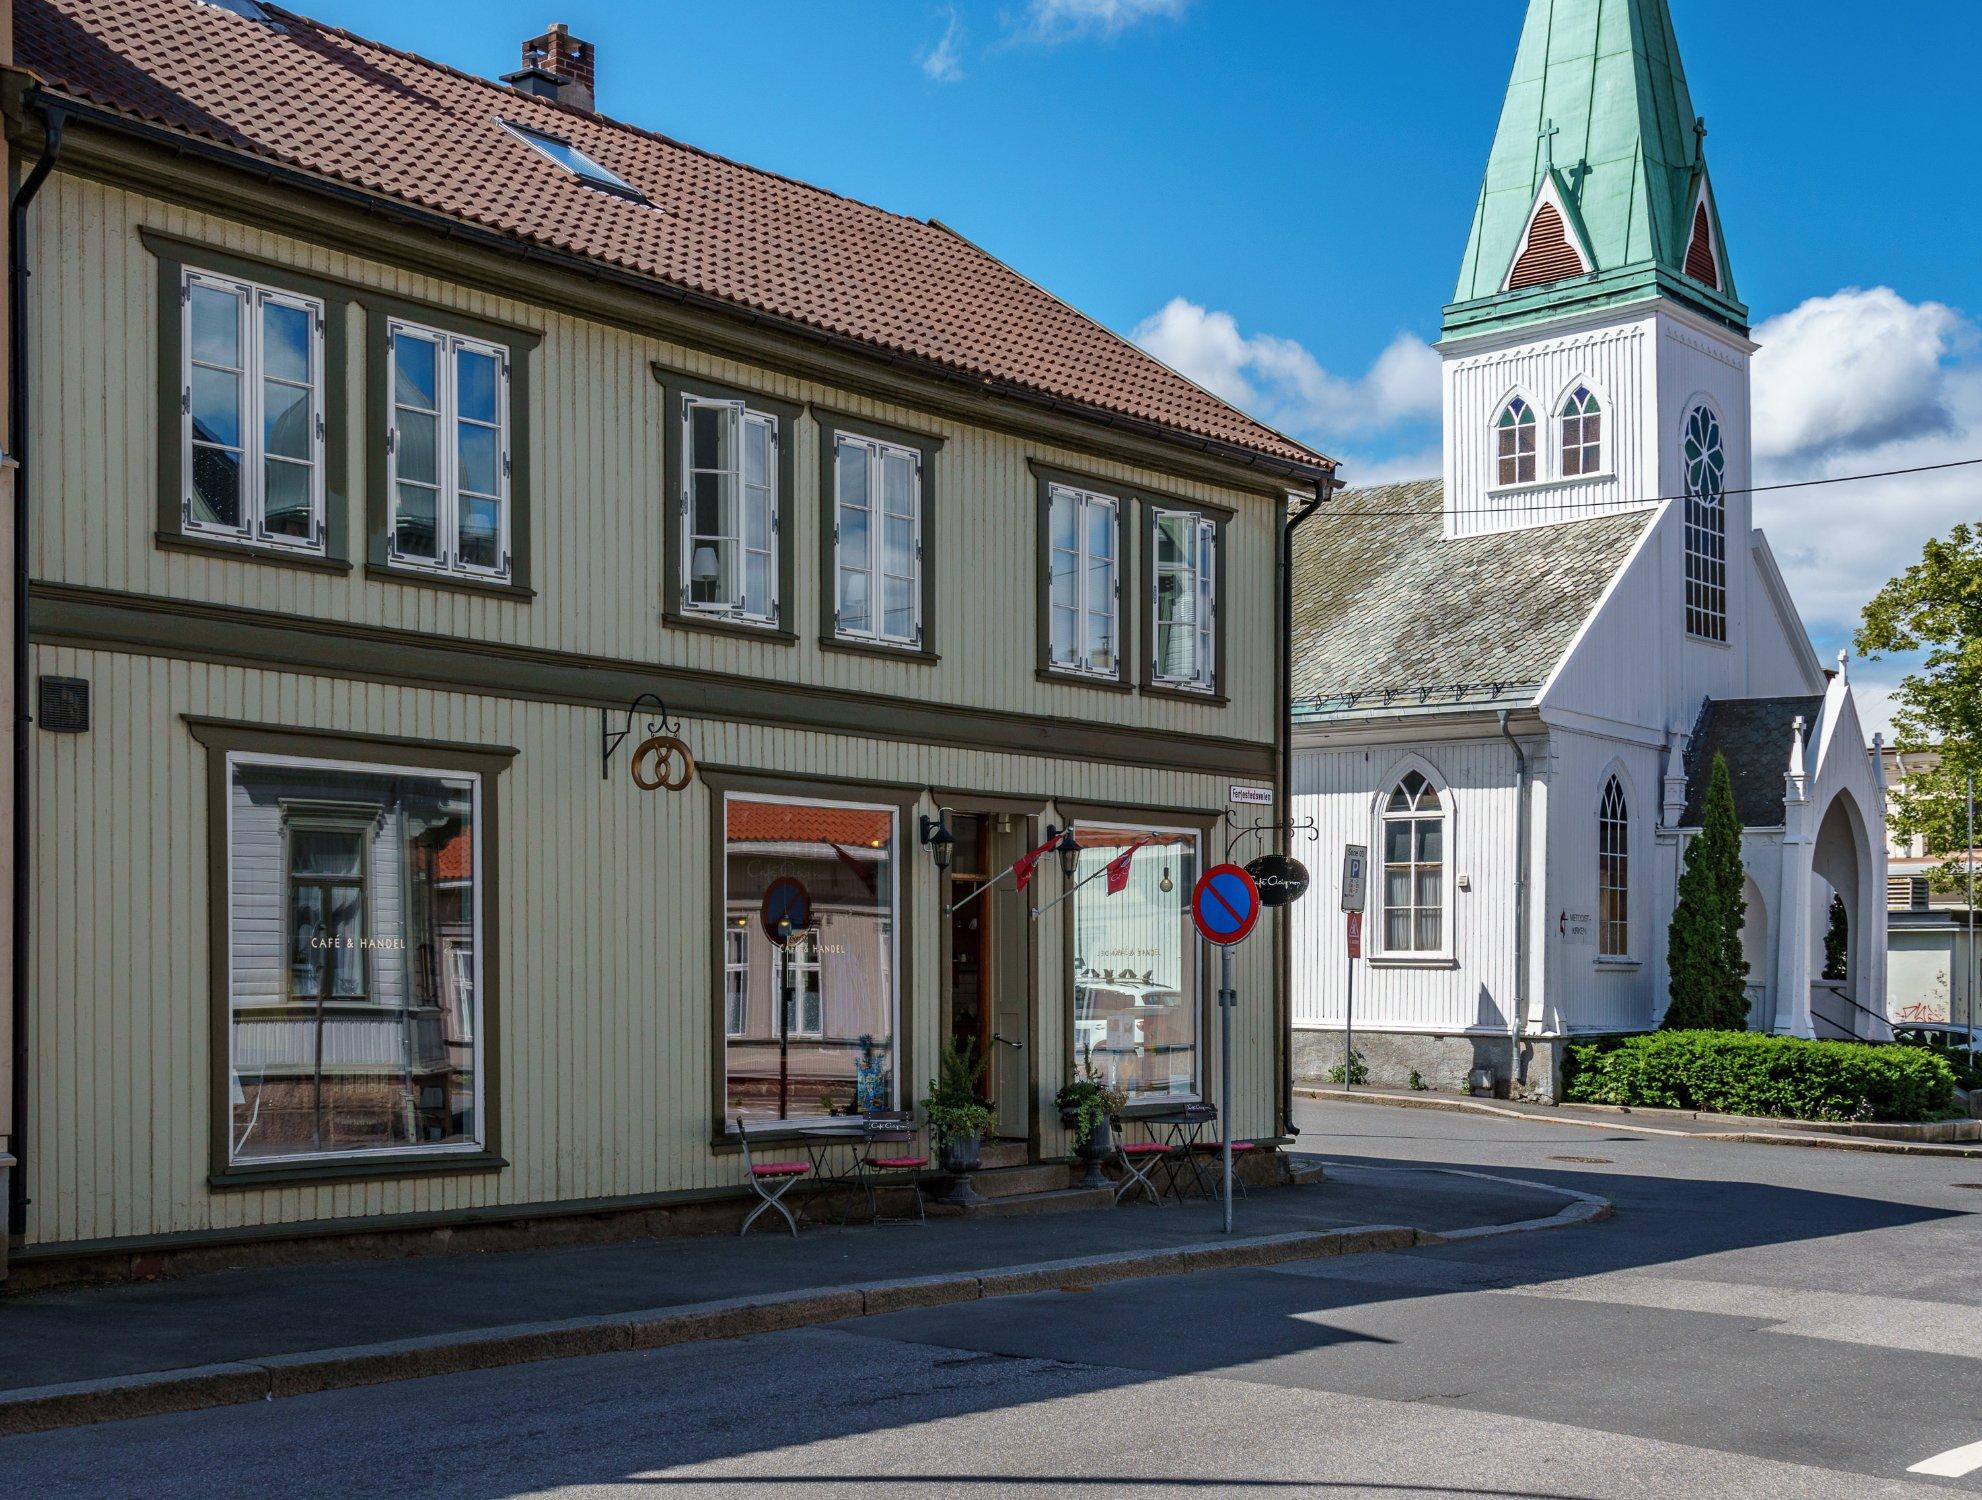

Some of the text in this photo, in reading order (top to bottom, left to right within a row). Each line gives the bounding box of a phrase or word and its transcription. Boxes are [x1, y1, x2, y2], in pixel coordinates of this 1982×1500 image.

[311, 934, 406, 949] CAFÉ & HANDEL
[812, 944, 845, 954] HANDEL
